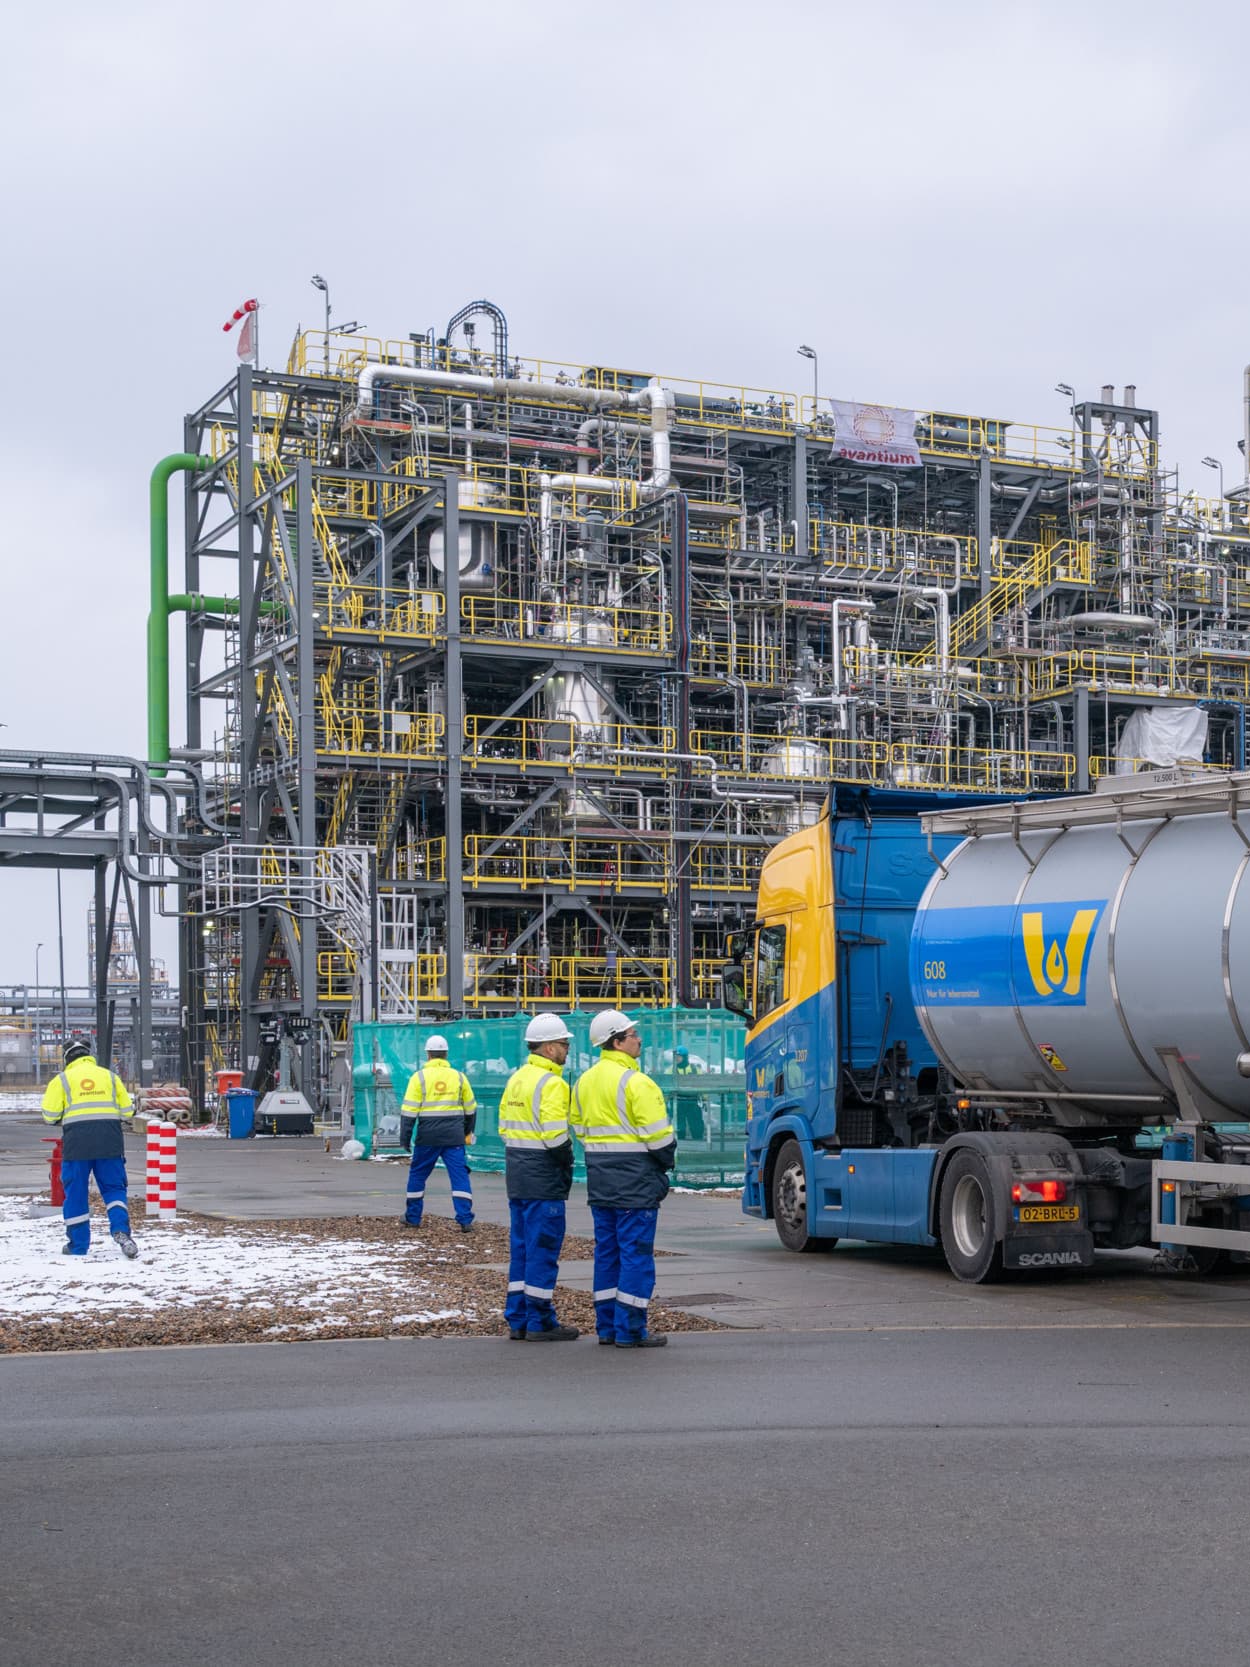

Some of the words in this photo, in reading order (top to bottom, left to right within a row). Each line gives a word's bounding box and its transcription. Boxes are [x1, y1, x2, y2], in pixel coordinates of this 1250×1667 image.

[839, 448, 917, 465] avantium
[924, 961, 947, 980] 608
[1023, 1208, 1076, 1220] 02-BRL-5
[1018, 1251, 1082, 1266] SCANIA
